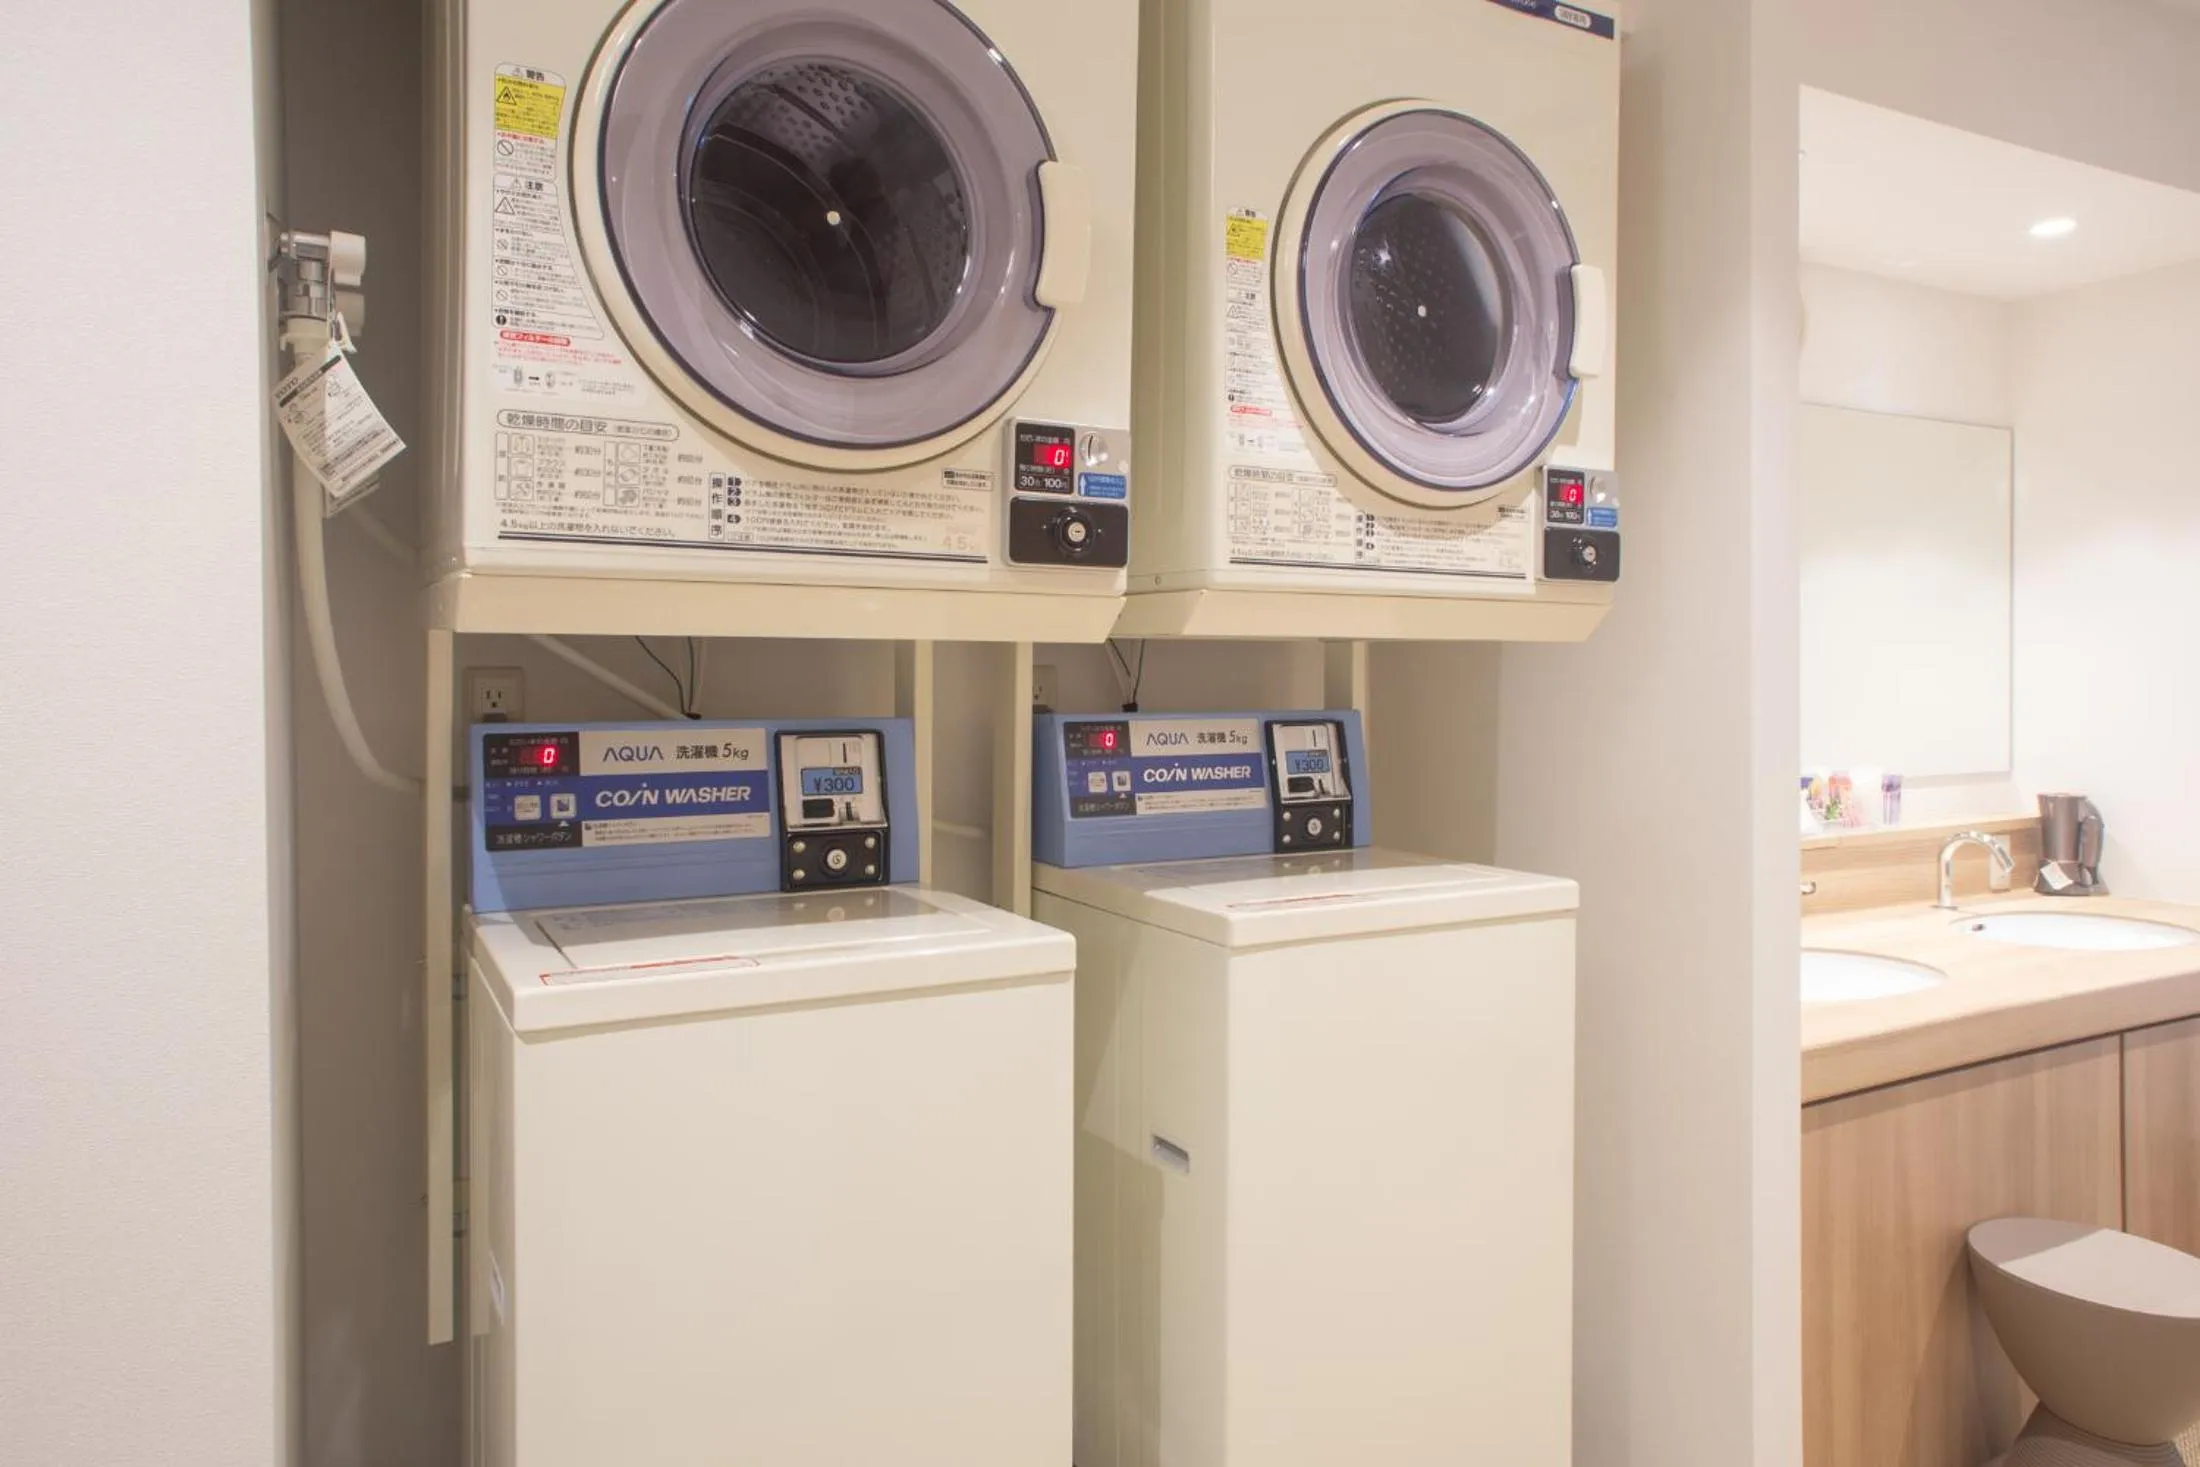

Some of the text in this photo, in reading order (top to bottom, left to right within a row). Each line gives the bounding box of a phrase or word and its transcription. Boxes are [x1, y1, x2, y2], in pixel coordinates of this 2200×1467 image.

[506, 413, 608, 433] 乾燥時間の目安
[1053, 449, 1065, 465] 0
[1105, 732, 1114, 747] 0
[1146, 732, 1189, 746] AQUA
[543, 747, 555, 764] 0
[602, 745, 665, 763] AQUA
[676, 743, 749, 761] 洗濯機 5kg
[1143, 763, 1251, 783] COIN WASHER
[813, 777, 855, 794] ¥300
[595, 782, 751, 808] COIN WASHER
